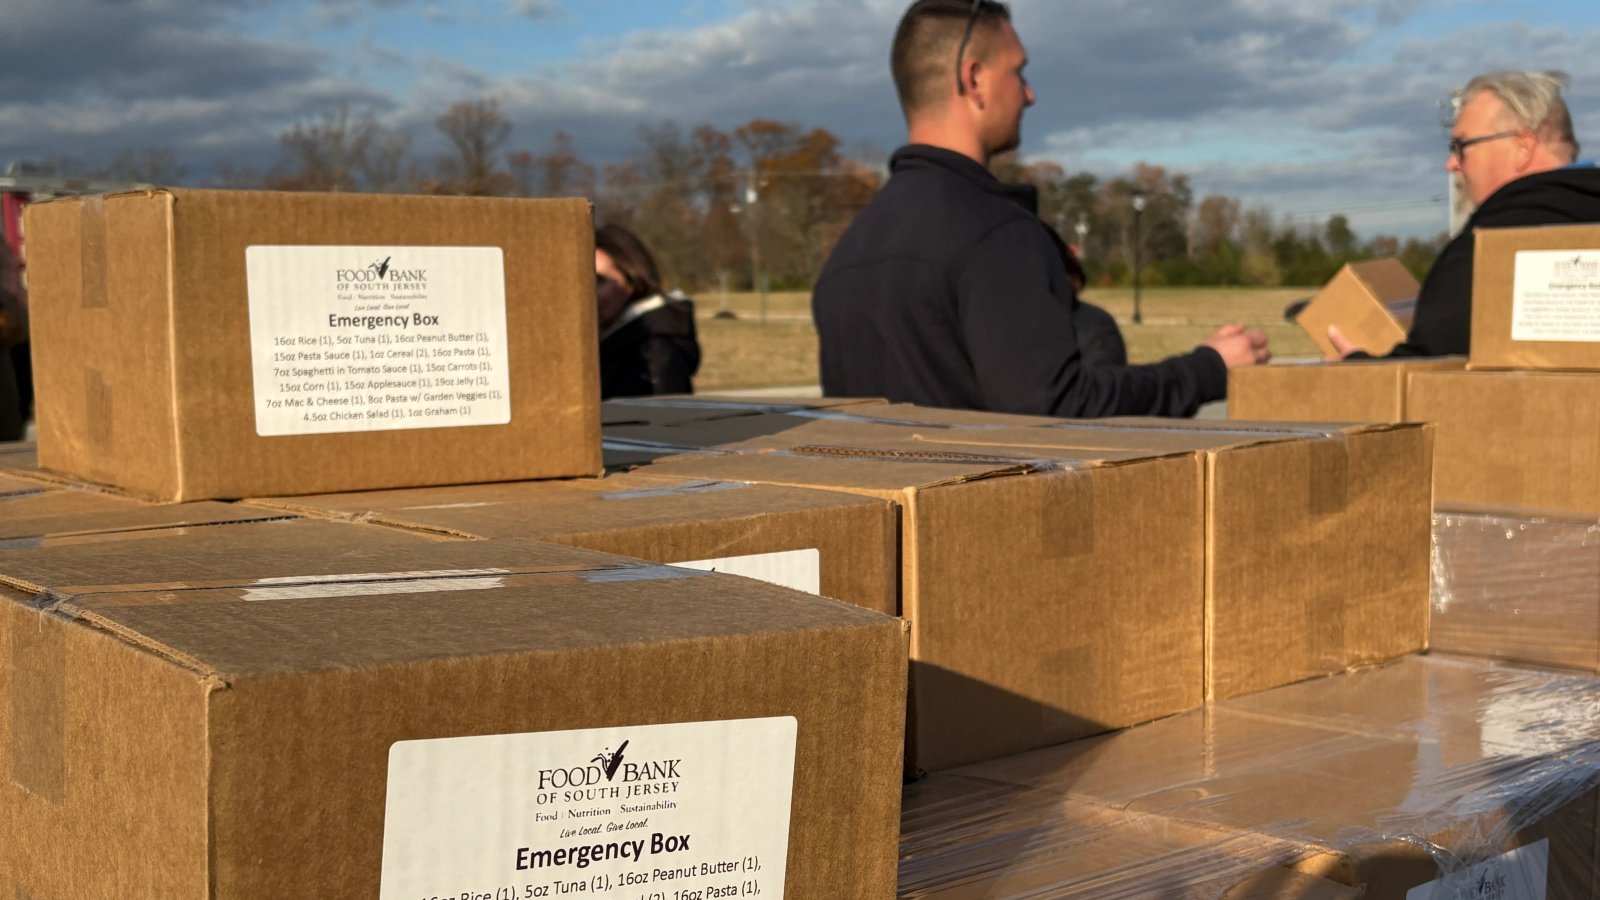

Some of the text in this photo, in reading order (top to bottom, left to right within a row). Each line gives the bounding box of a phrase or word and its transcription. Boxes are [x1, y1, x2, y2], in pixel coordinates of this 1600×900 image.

[336, 269, 428, 282] FOOD BANK
[336, 283, 427, 291] OF SOUTH JERSEY
[329, 312, 439, 330] Emergency Box
[274, 333, 489, 347] 16oz Rice (1), 5oz Tuna (1), 16oz Peanut Butter (1),
[274, 348, 491, 362] 15oz Pasta Sauce (1), 1oz Cereal (2), 16oz Pasta (1),
[274, 362, 492, 378] 7oz Spaghetti in Tomato Sauce (1), 15oz Carrots (1),
[280, 377, 490, 392] 15oz Corn (1), 15oz Applesauce (1), 19oz Jelly (1),
[266, 390, 502, 408] 7oz Mac & Cheese (1), 8oz Pasta w/ Garden Veggies (1),
[304, 406, 471, 422] 4.5oz Chicken Salad (1), 1oz Graham (1)
[537, 759, 682, 790] FOOD BANK
[536, 781, 680, 804] OF SOUTH JERSEY
[536, 800, 678, 822] Food Nutrition Sustainability
[560, 828, 576, 838] Live
[606, 822, 624, 832] Give
[516, 832, 690, 870] Emergency Box
[524, 884, 549, 898] 5oz
[554, 880, 586, 895] Tuna
[591, 874, 613, 893] (1),
[618, 872, 649, 887] 16oz
[652, 865, 698, 882] Peanut
[700, 860, 740, 876] Butter
[742, 856, 762, 875] (1),
[706, 884, 738, 900] Pasta
[742, 880, 761, 898] (1),
